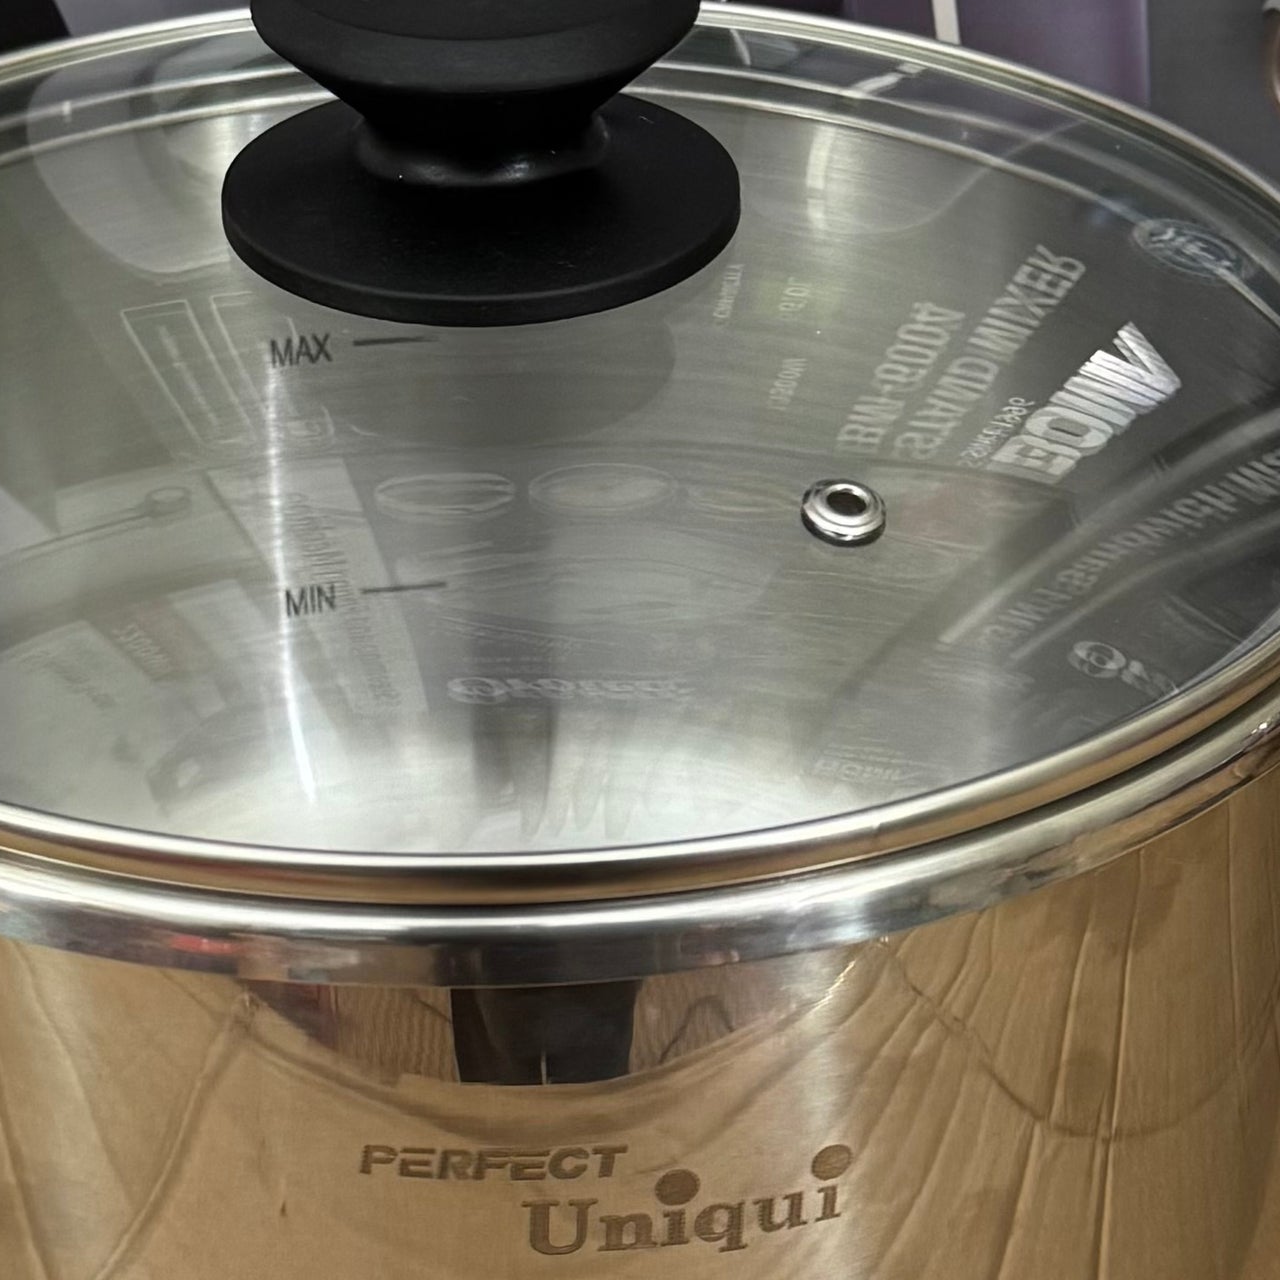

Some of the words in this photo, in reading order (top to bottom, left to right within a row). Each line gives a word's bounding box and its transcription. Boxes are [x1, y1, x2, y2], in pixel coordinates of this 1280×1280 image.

[270, 333, 334, 367] MAX
[285, 585, 337, 617] MIN
[359, 1144, 628, 1182] PERFECT
[520, 1144, 854, 1257] Uniqui
